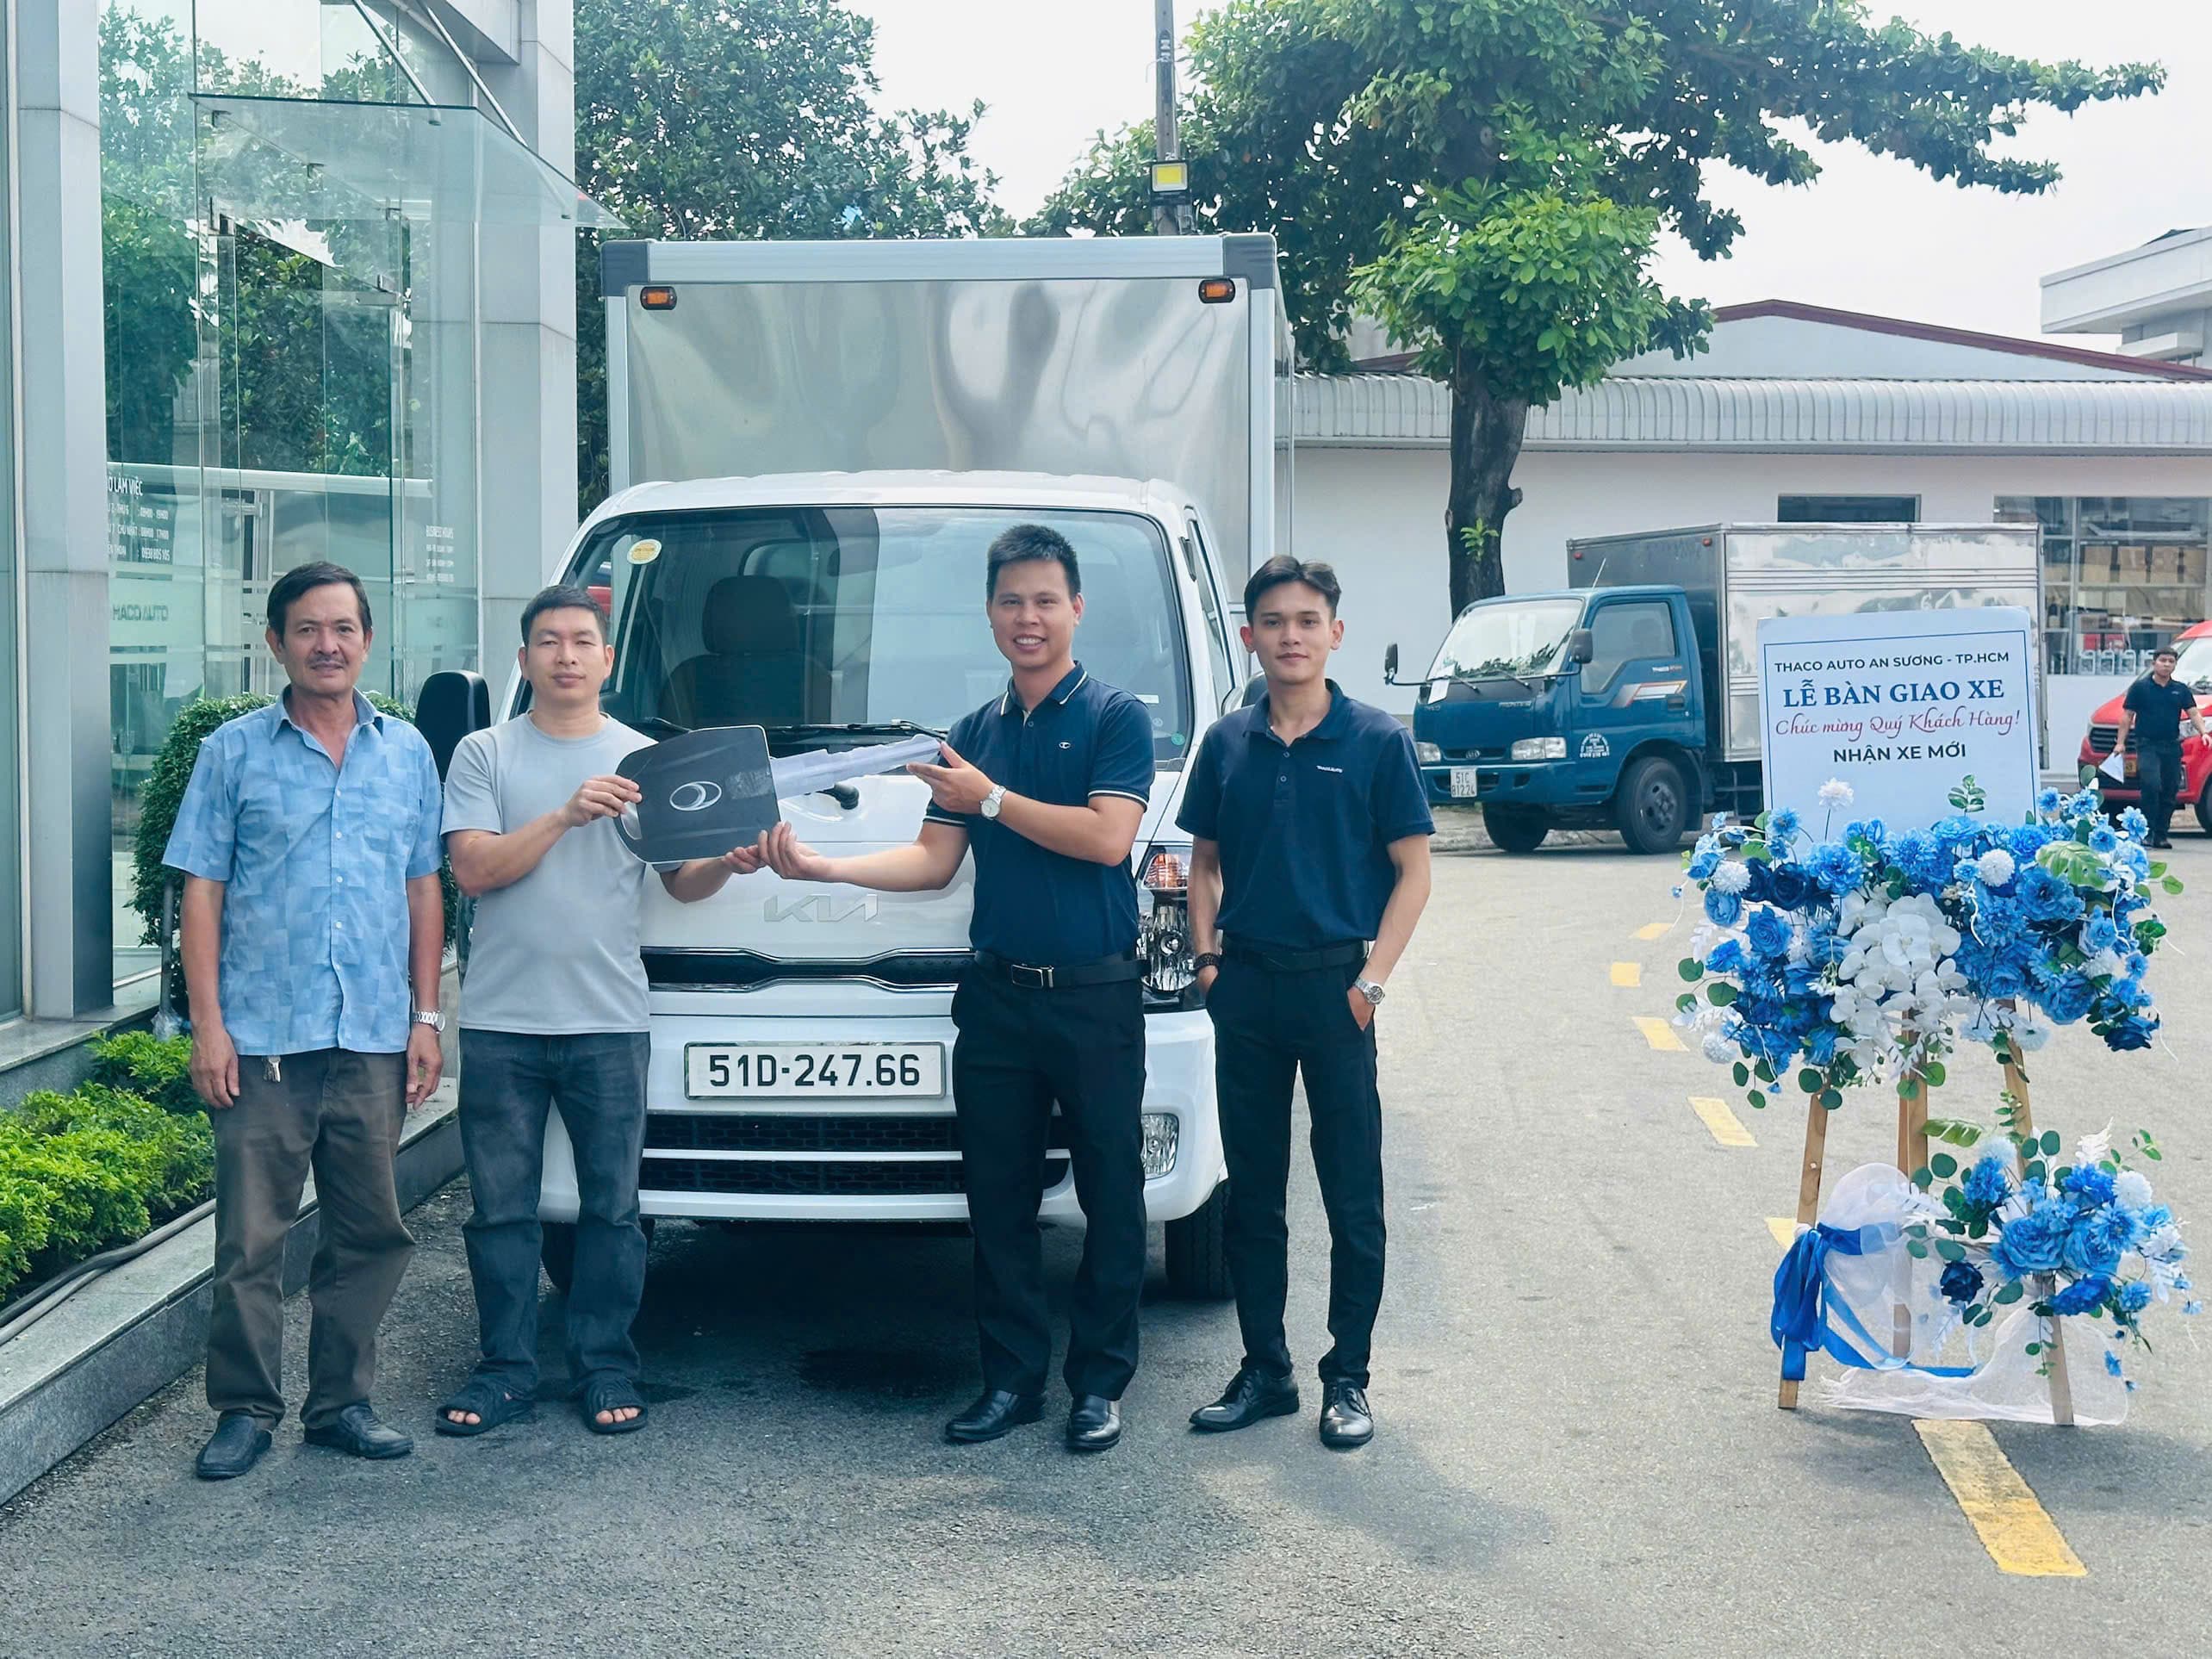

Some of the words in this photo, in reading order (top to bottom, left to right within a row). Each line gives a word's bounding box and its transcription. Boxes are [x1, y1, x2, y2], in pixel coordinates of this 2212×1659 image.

[112, 605, 141, 621] HACO
[1774, 661, 1823, 673] THACO
[1827, 658, 1865, 671] AUTO
[1869, 658, 1889, 668] AN
[1893, 655, 1943, 668] SƯƠNG
[1955, 652, 2010, 664] TP.HCM
[1783, 679, 1817, 707] LỄ
[1824, 680, 1881, 705] BÀN
[1889, 681, 1960, 702] GIAO
[1967, 679, 2004, 699] XE
[1775, 712, 1819, 735] Chúc
[1870, 715, 1903, 739] Quý
[1908, 705, 1967, 733] Khách
[1969, 709, 2020, 736] Hàng!
[1833, 744, 1891, 765] NHẬN
[1897, 745, 1922, 760] XE
[1928, 741, 1966, 758] MỚI
[763, 894, 878, 923] KIA
[709, 1053, 920, 1087] 51D-247.66
